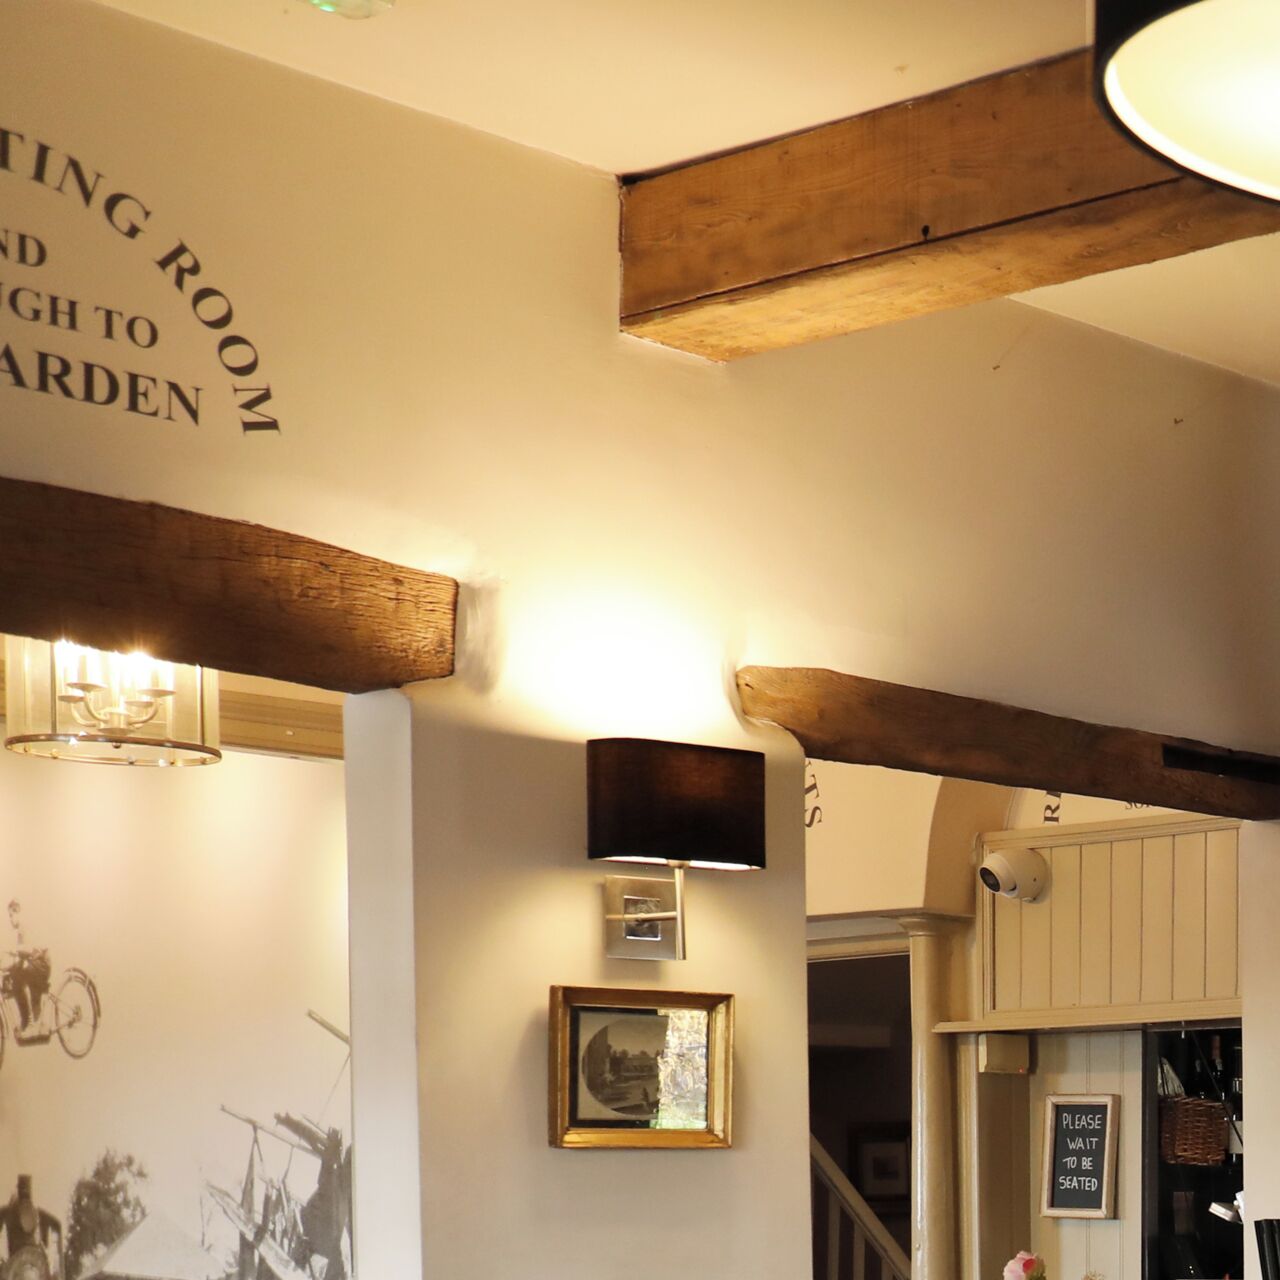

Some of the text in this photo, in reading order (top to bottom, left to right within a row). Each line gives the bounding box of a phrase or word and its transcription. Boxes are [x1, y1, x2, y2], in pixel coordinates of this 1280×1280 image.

[0, 282, 158, 348] GH TO
[154, 239, 281, 435] ROOM
[1062, 1113, 1102, 1129] PLEASE
[1067, 1137, 1098, 1150] WAIT
[1062, 1156, 1093, 1170] TO BE
[1059, 1176, 1098, 1191] SEATED
